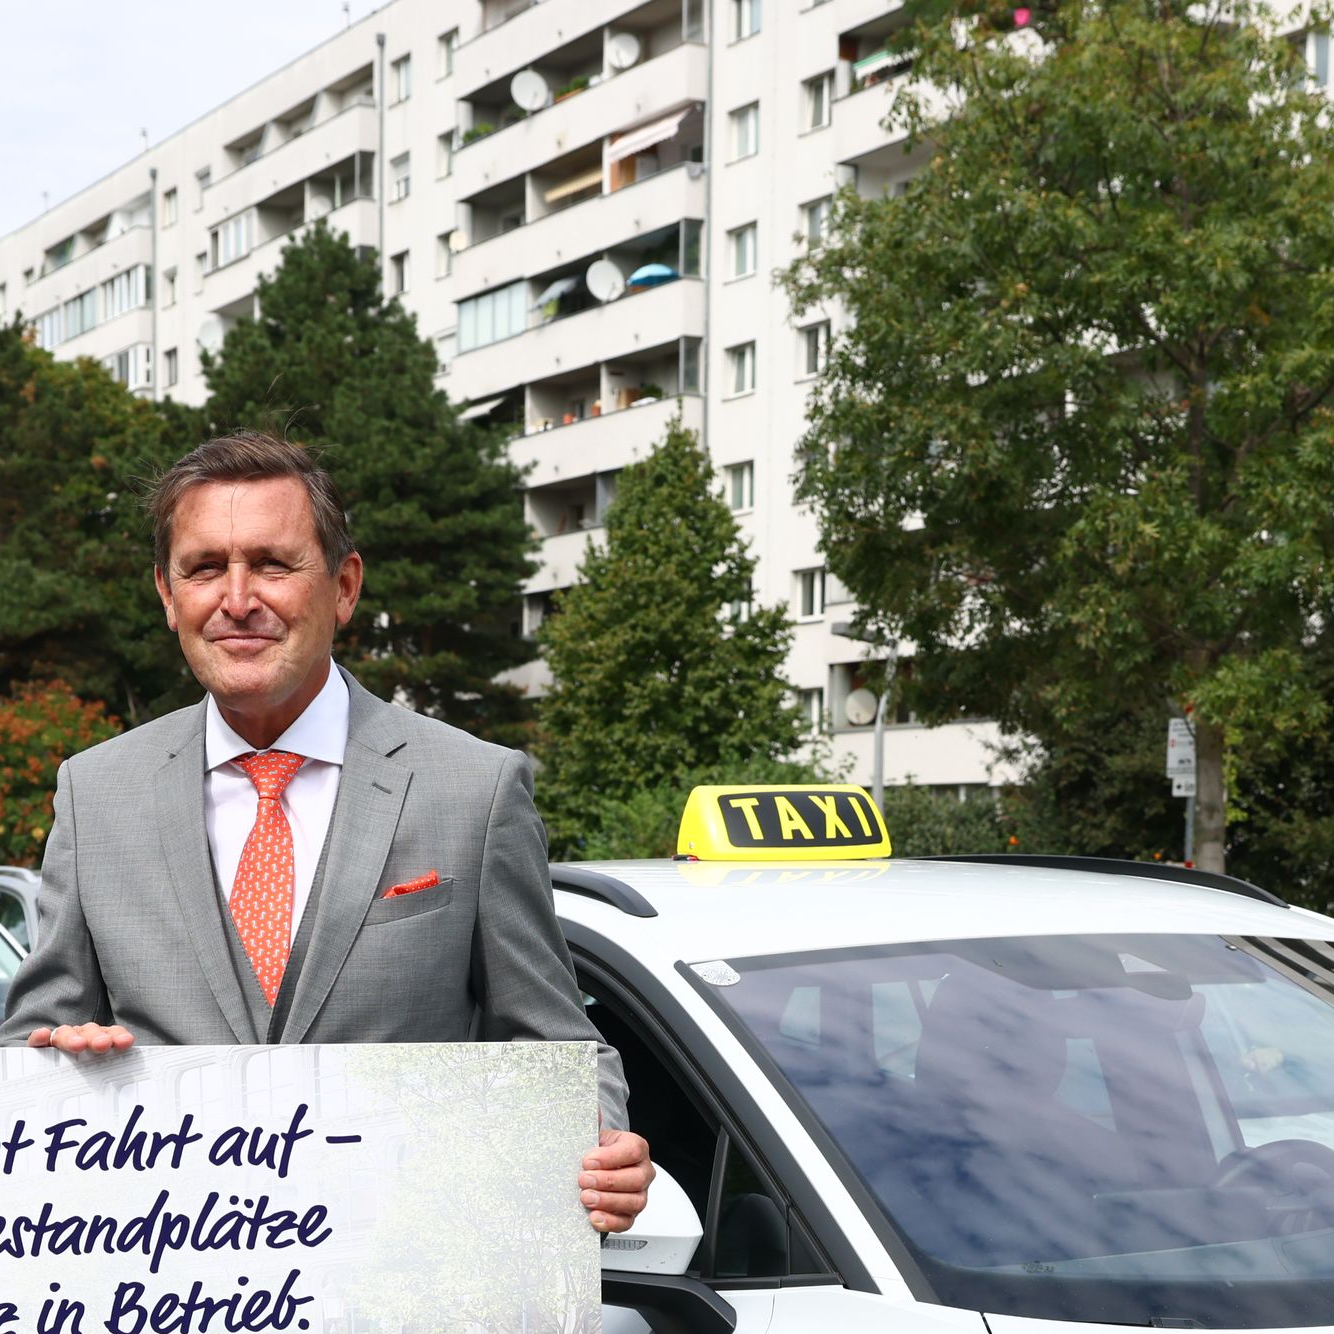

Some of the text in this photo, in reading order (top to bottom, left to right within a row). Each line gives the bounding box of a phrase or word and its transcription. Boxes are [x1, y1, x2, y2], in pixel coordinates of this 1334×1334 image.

[729, 795, 873, 840] TAXI
[44, 1104, 204, 1172] Fahrt
[208, 1103, 314, 1179] auf
